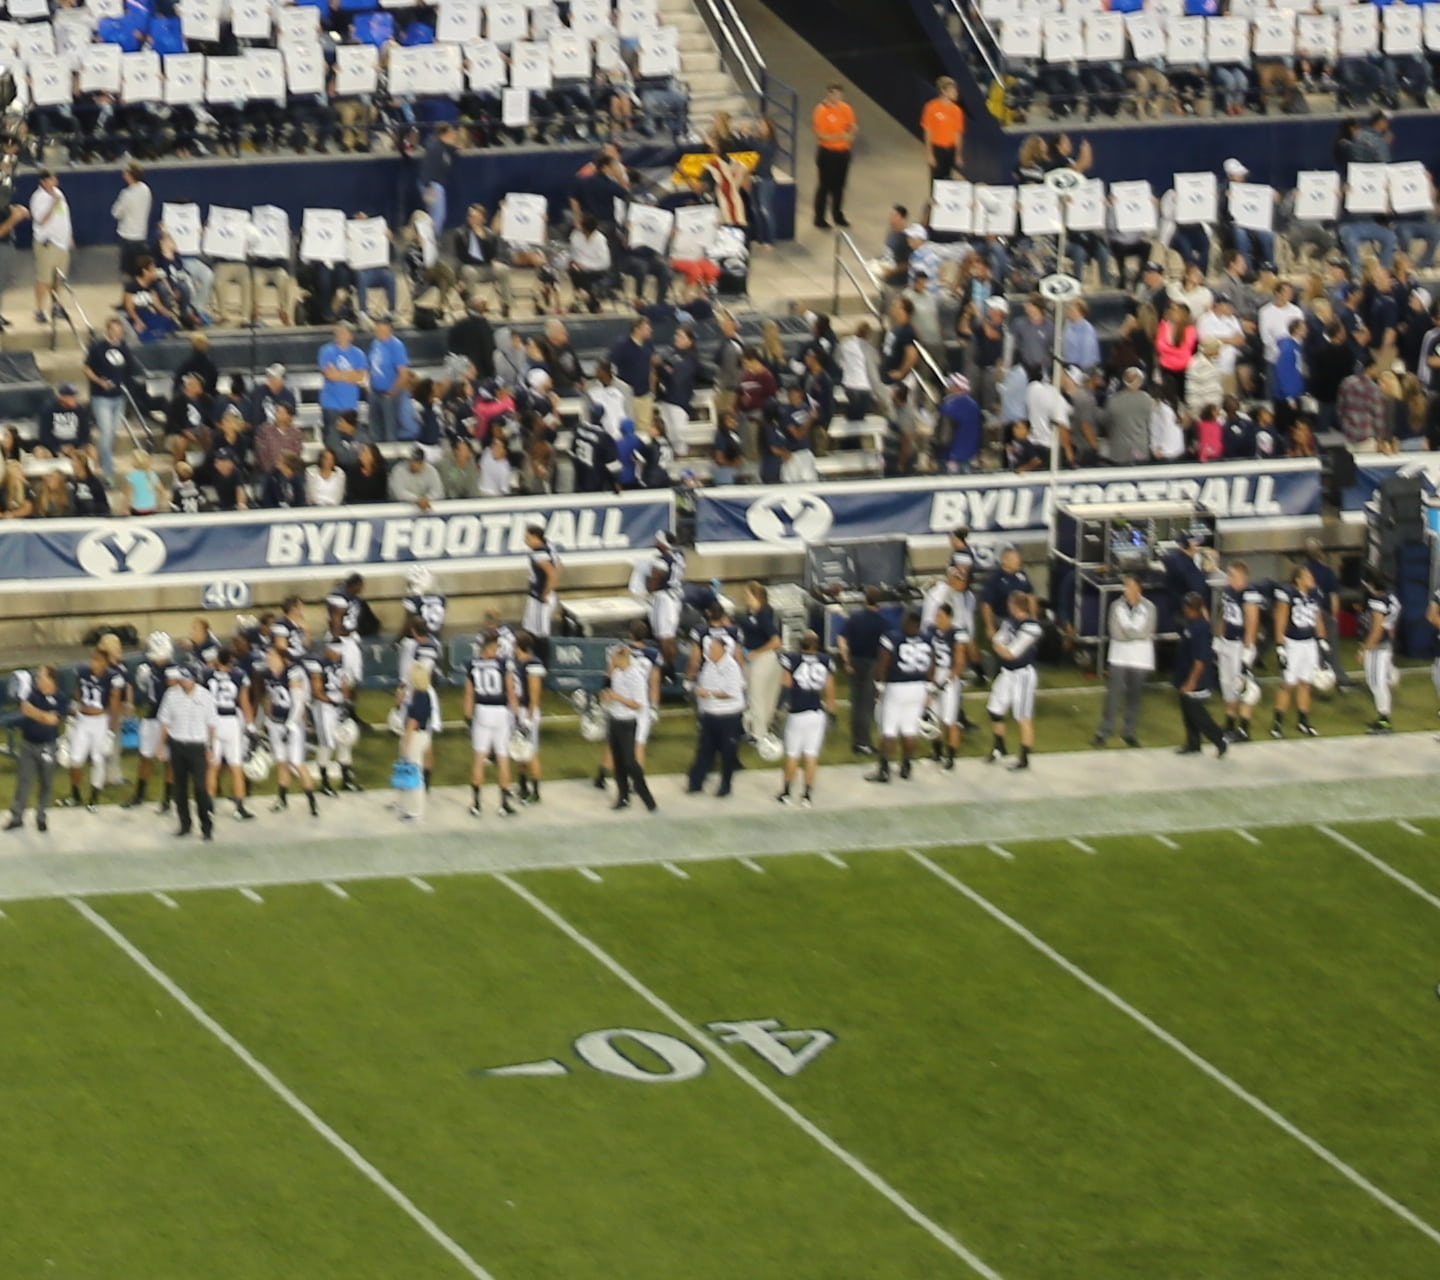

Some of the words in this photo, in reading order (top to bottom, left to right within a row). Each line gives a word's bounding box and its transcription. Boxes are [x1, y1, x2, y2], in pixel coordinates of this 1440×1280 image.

[928, 488, 1032, 534] BYU
[266, 518, 370, 566] BYU
[205, 582, 248, 608] 40
[470, 667, 504, 696] 10
[569, 1015, 842, 1085] 40
